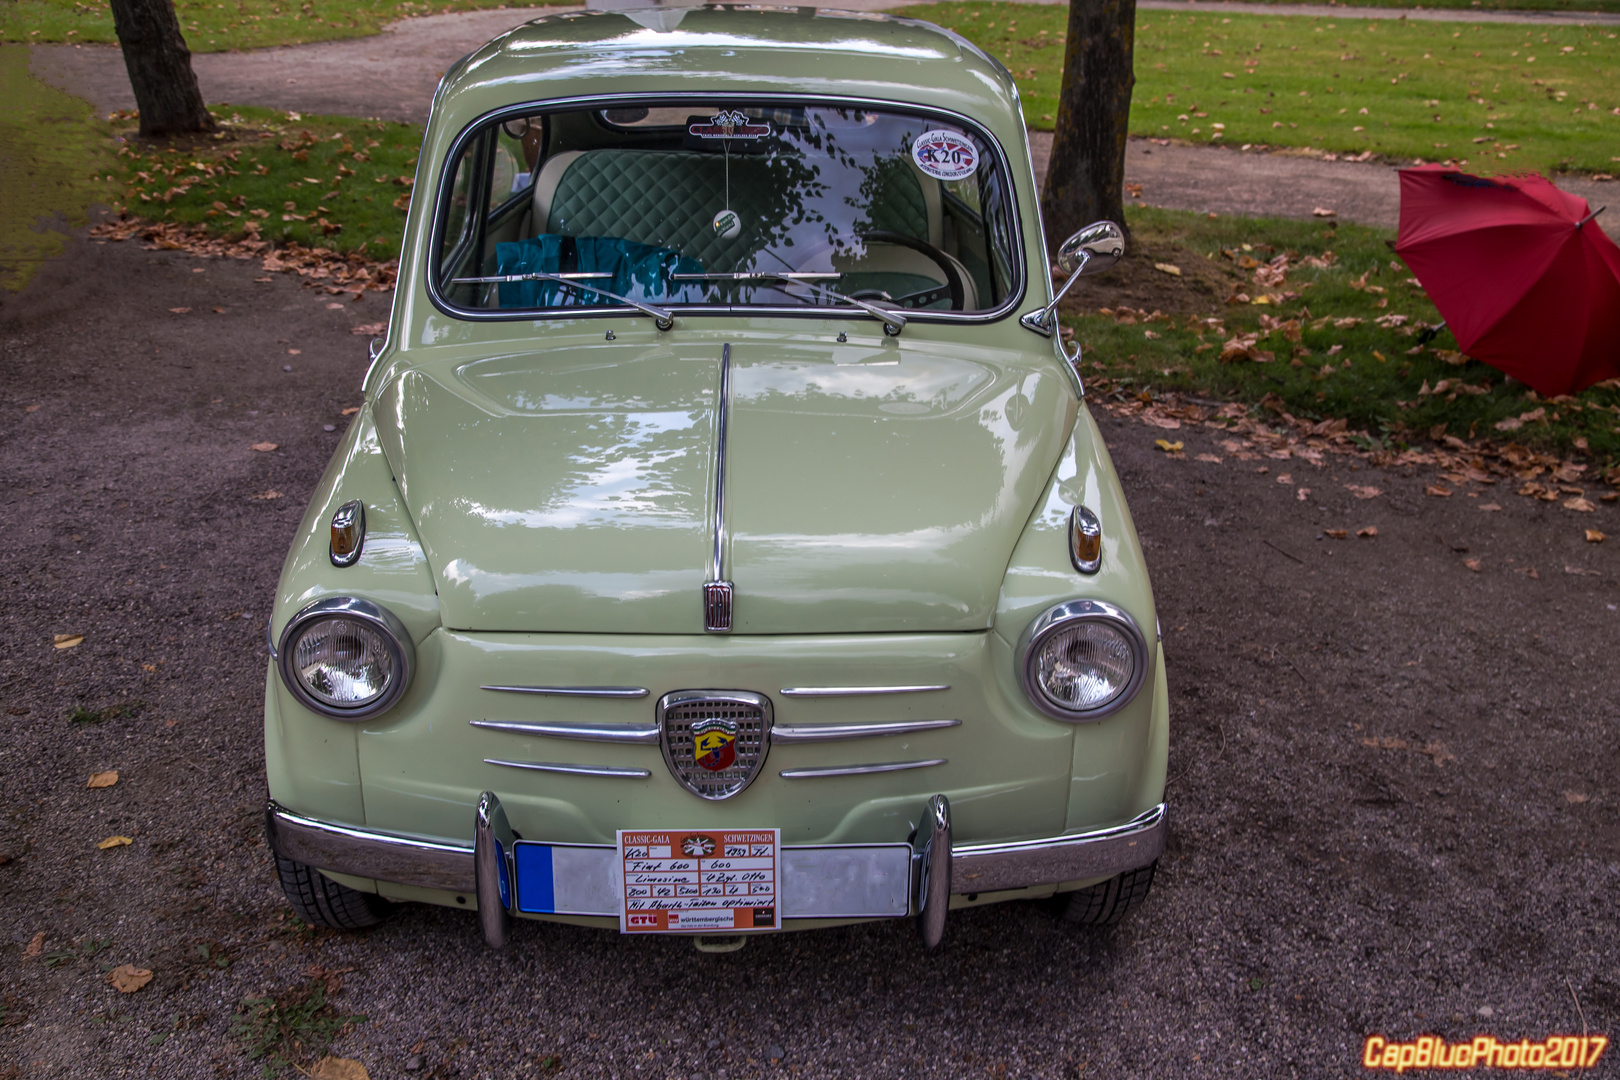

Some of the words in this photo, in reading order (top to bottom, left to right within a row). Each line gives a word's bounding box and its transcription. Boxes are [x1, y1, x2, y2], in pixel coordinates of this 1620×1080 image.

[927, 149, 961, 165] K20
[624, 835, 670, 844] CLASSIC-GALA
[724, 833, 773, 843] SCHWETZINGEN
[669, 861, 689, 870] 600
[711, 860, 731, 869] 600
